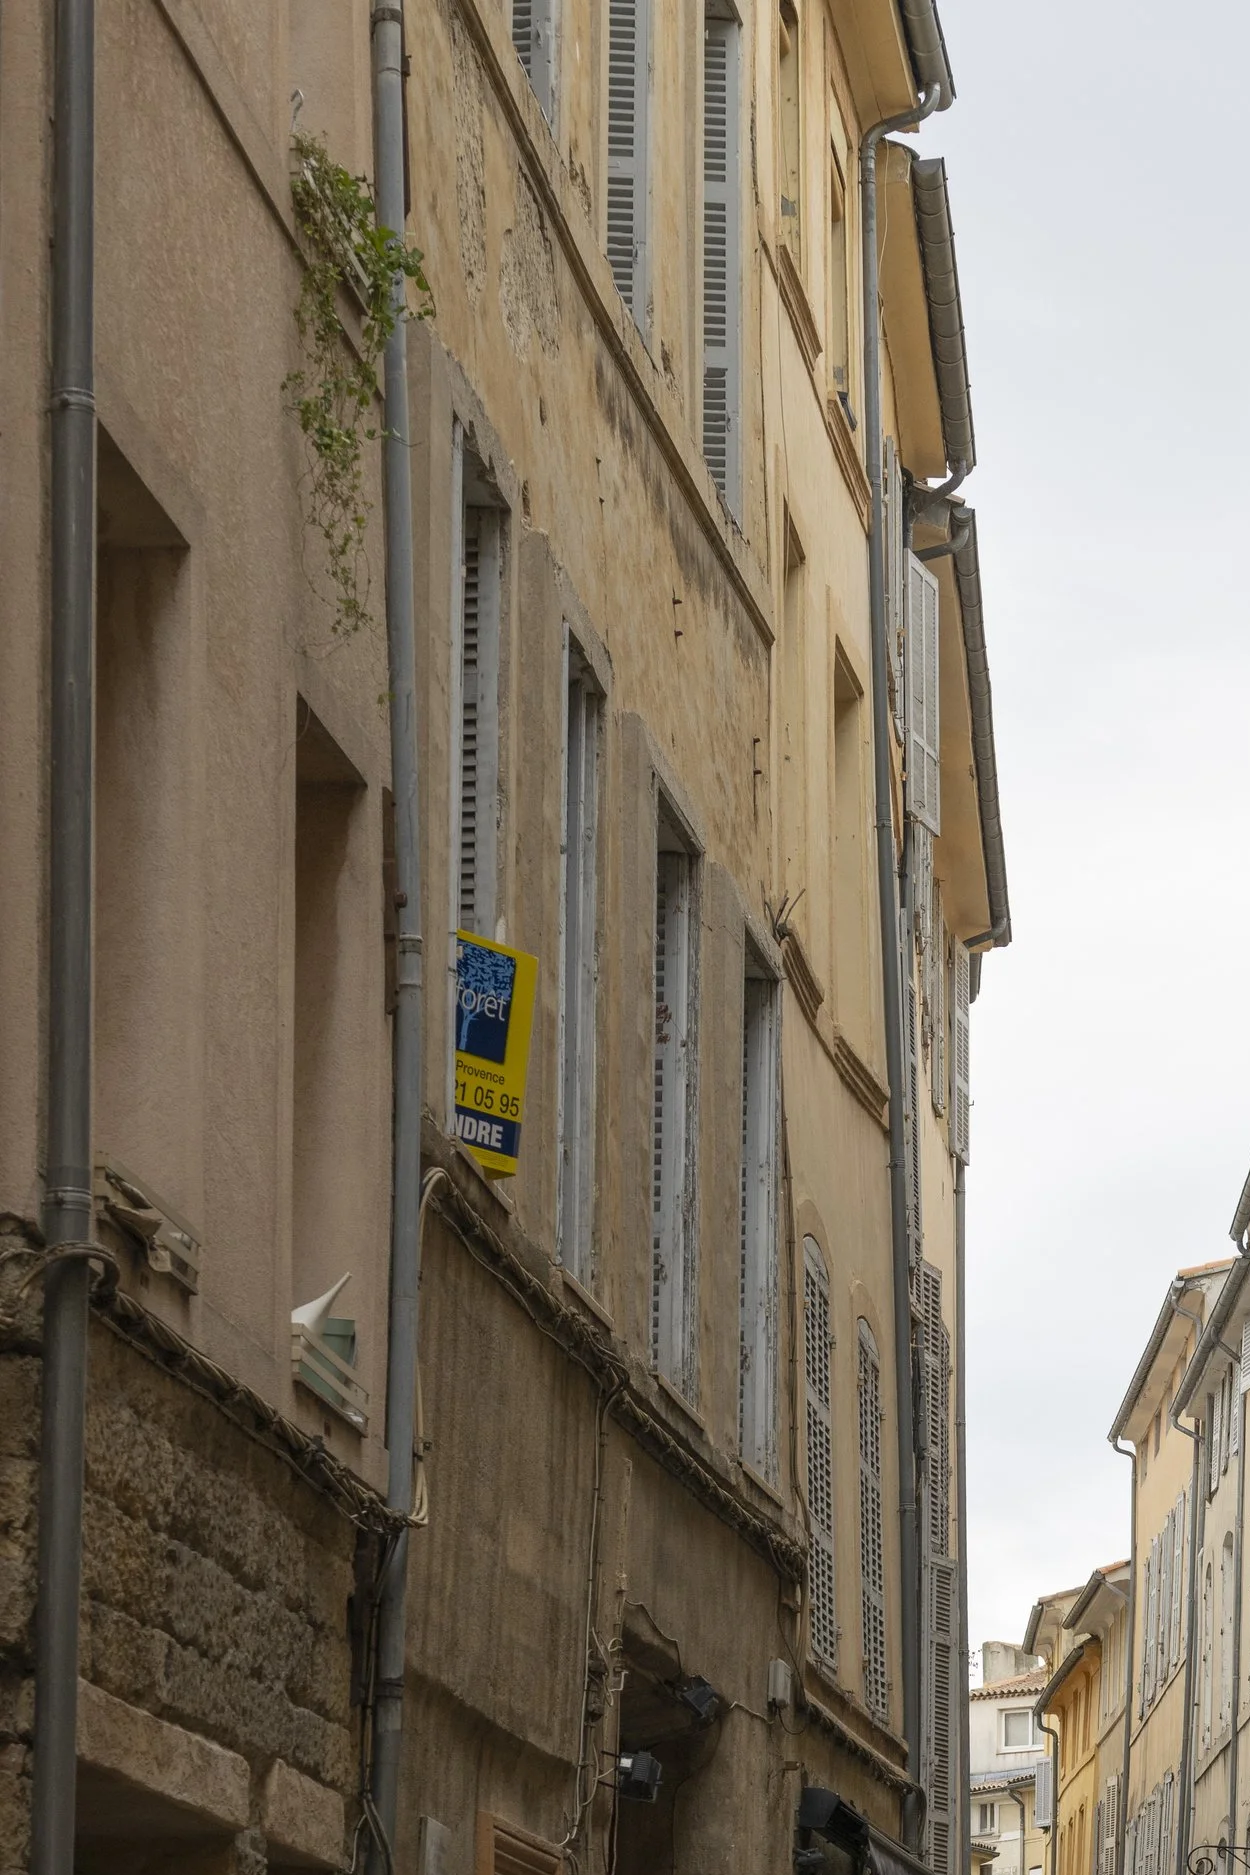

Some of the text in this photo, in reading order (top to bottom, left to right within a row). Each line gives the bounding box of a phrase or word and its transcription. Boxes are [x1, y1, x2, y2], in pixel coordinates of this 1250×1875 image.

[456, 1059, 505, 1085] Provence
[474, 1086, 494, 1109] 05
[500, 1094, 520, 1117] 95
